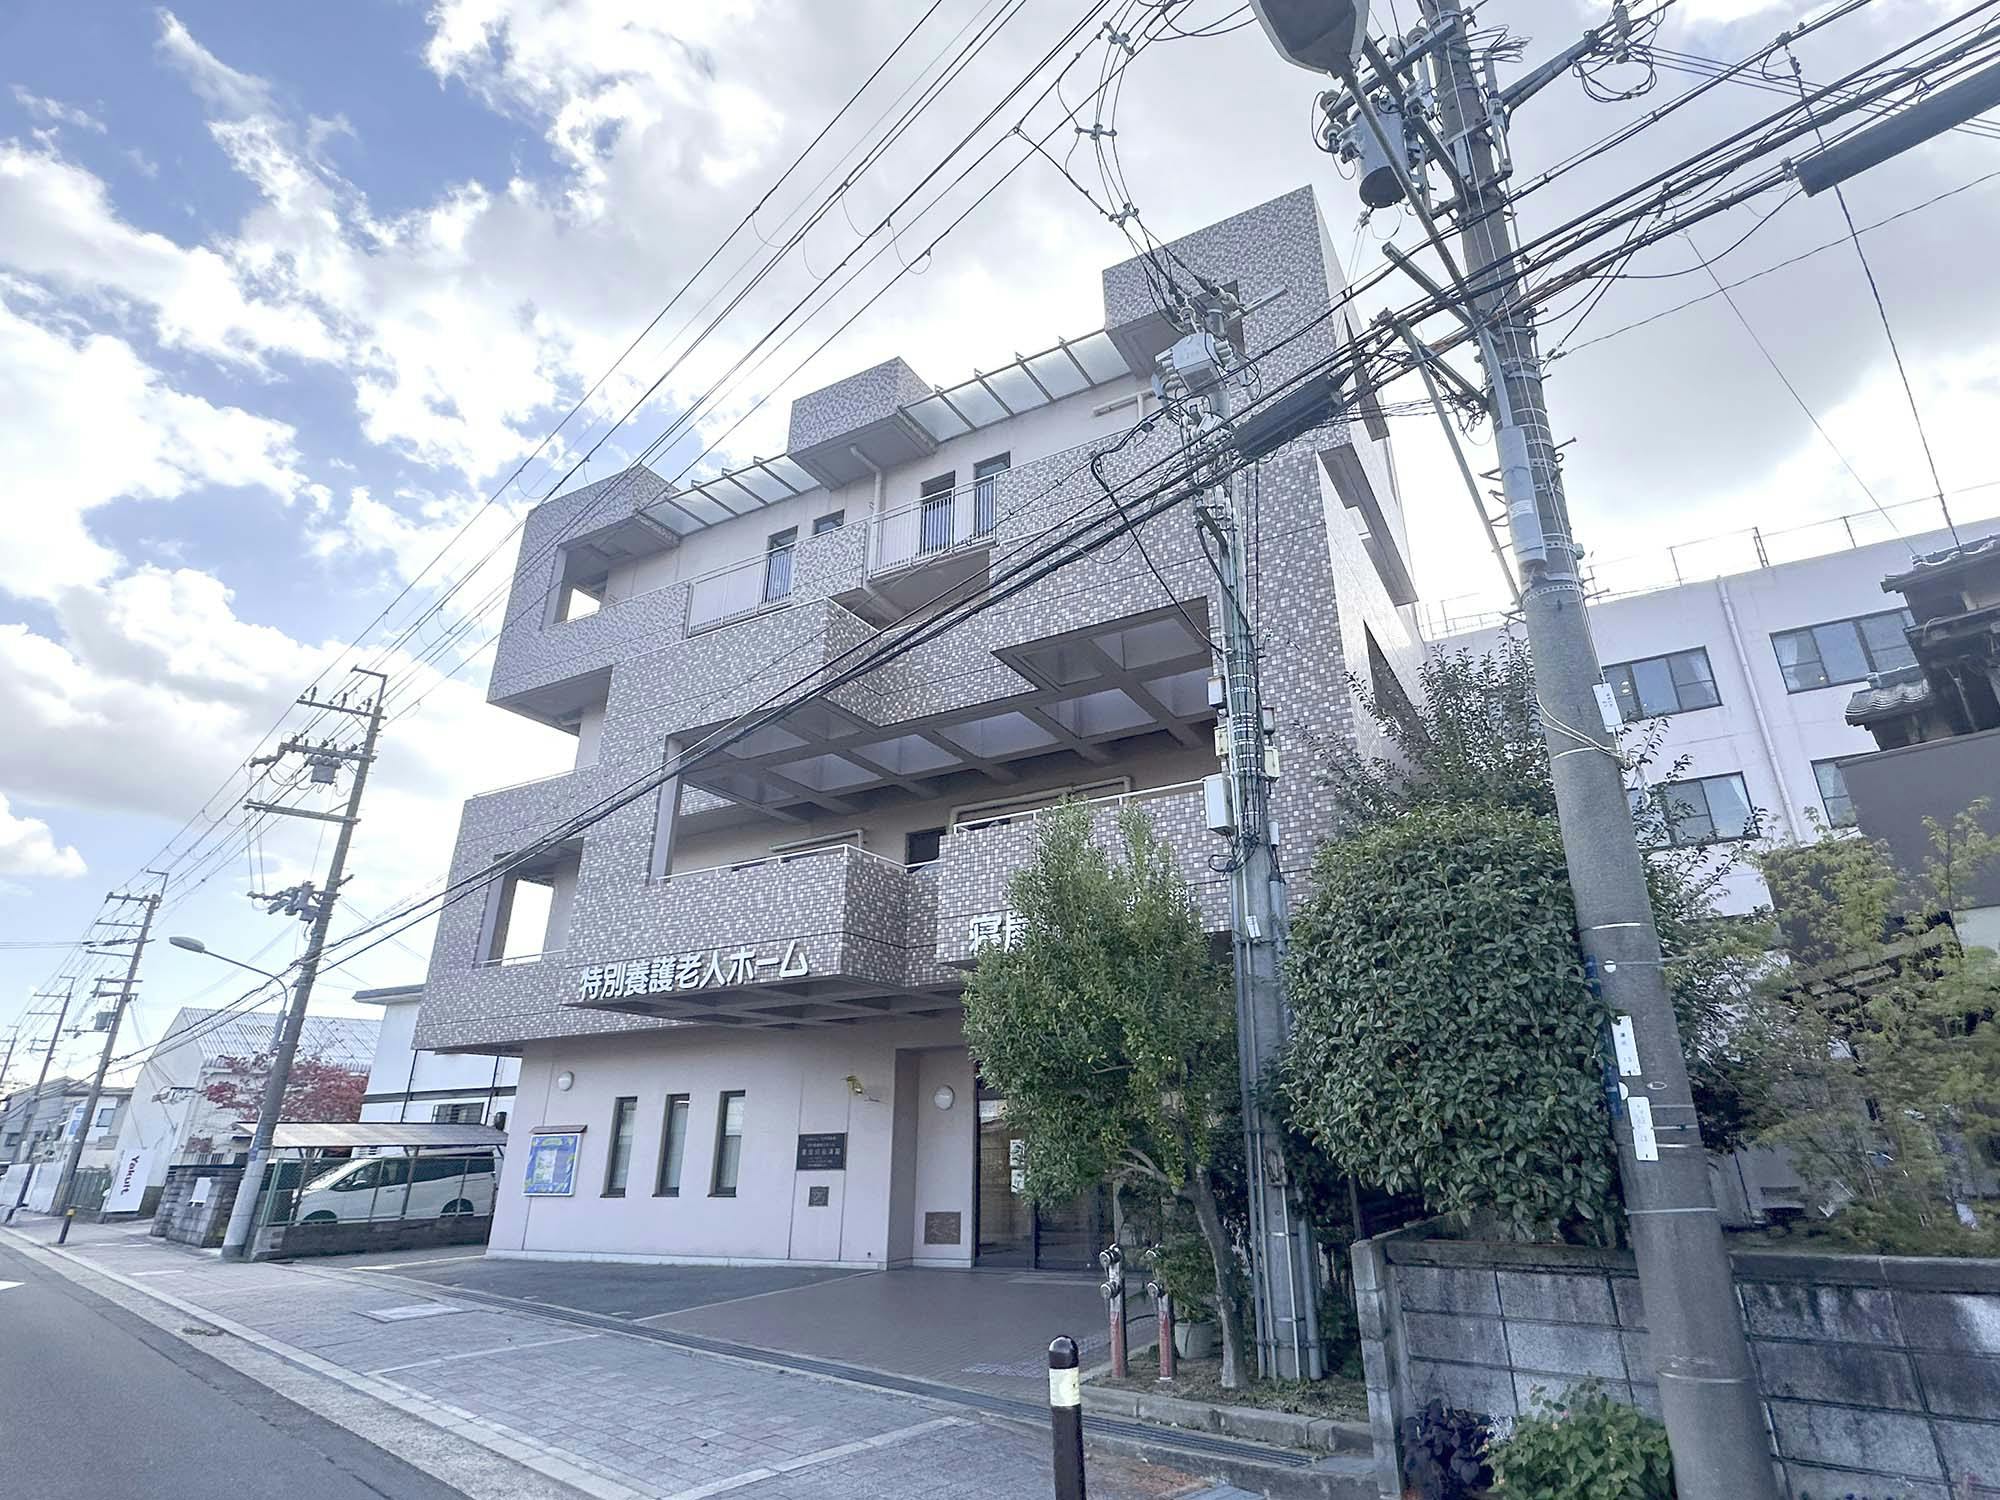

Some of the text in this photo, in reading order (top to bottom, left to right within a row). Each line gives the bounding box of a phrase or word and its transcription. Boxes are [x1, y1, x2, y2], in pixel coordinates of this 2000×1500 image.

[579, 939, 809, 1000] 特別養護老人ホーム
[120, 1155, 140, 1196] Yakult
